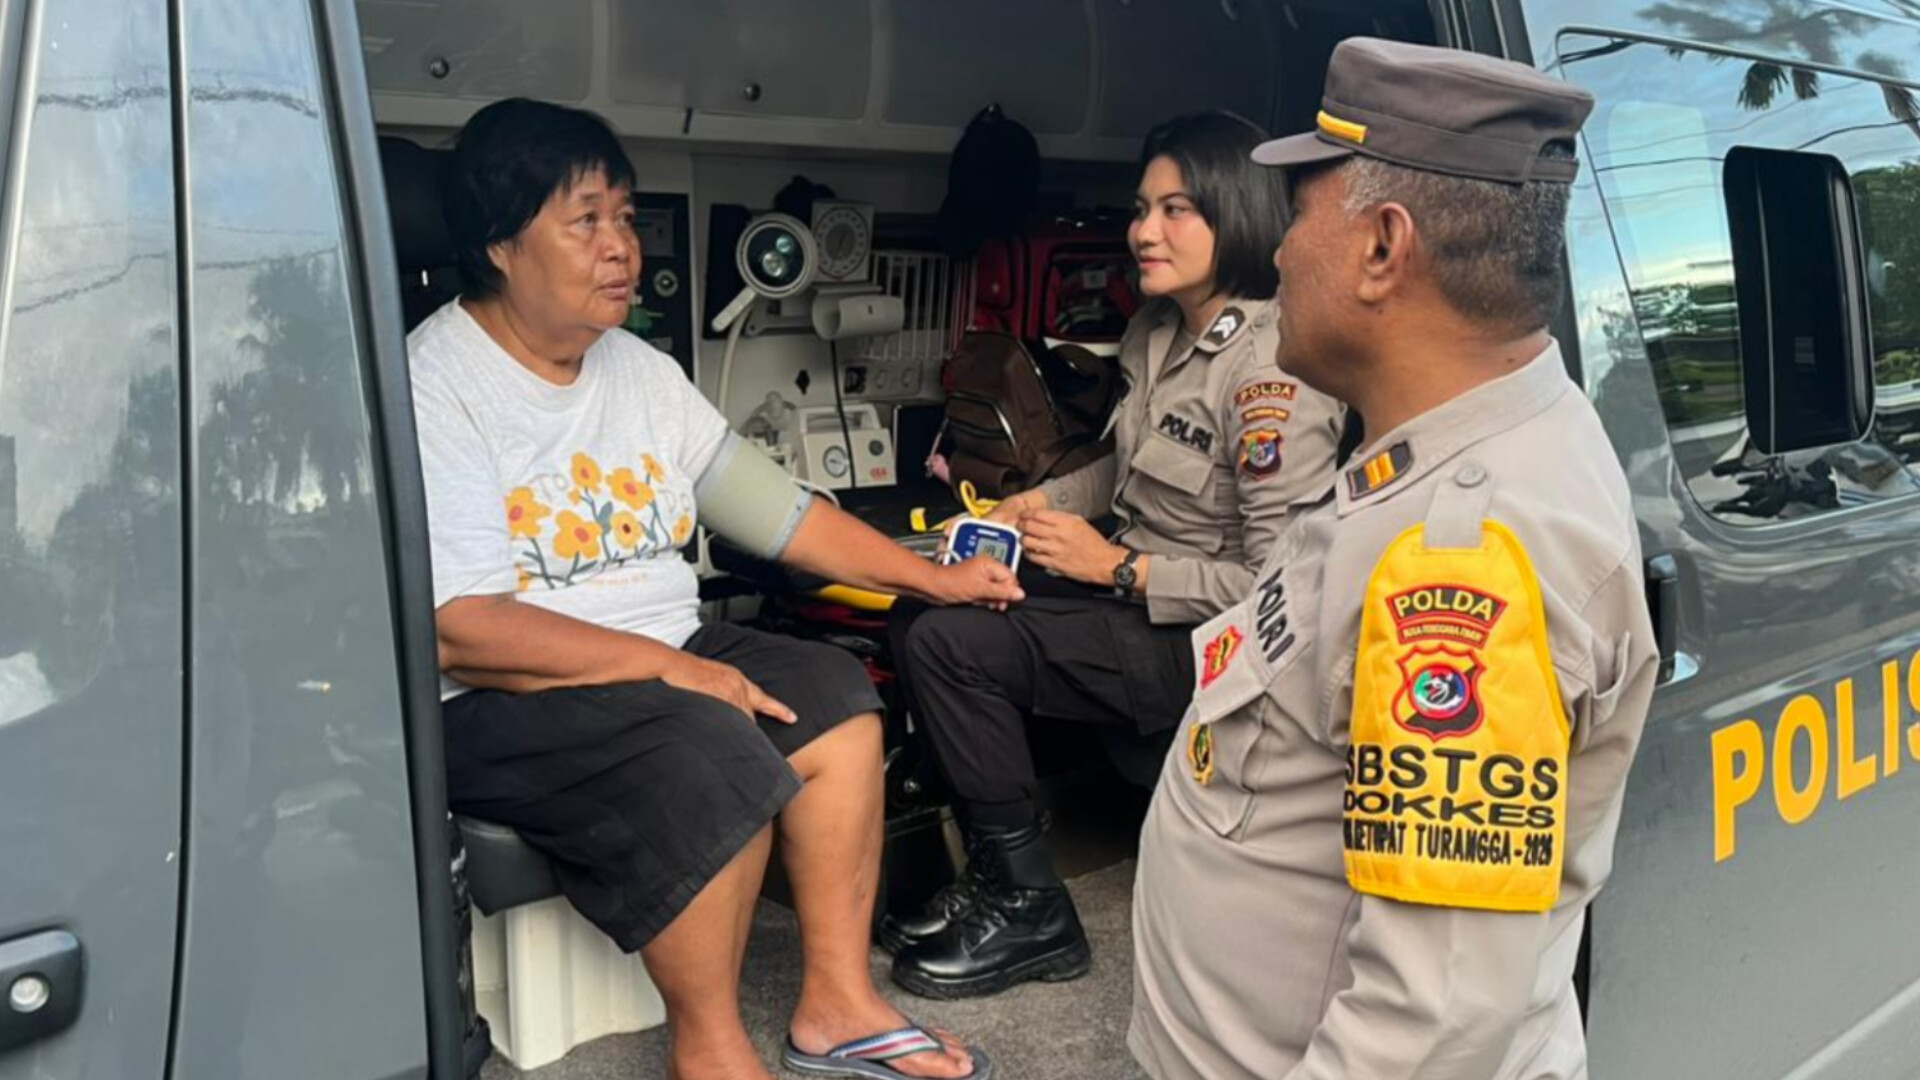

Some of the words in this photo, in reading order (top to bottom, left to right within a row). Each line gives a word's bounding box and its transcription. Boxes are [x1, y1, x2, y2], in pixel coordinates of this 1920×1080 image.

[1240, 384, 1291, 400] POLDA
[1159, 412, 1214, 453] POLRI
[1394, 588, 1492, 621] POLDA
[1343, 790, 1555, 828] DOKKES
